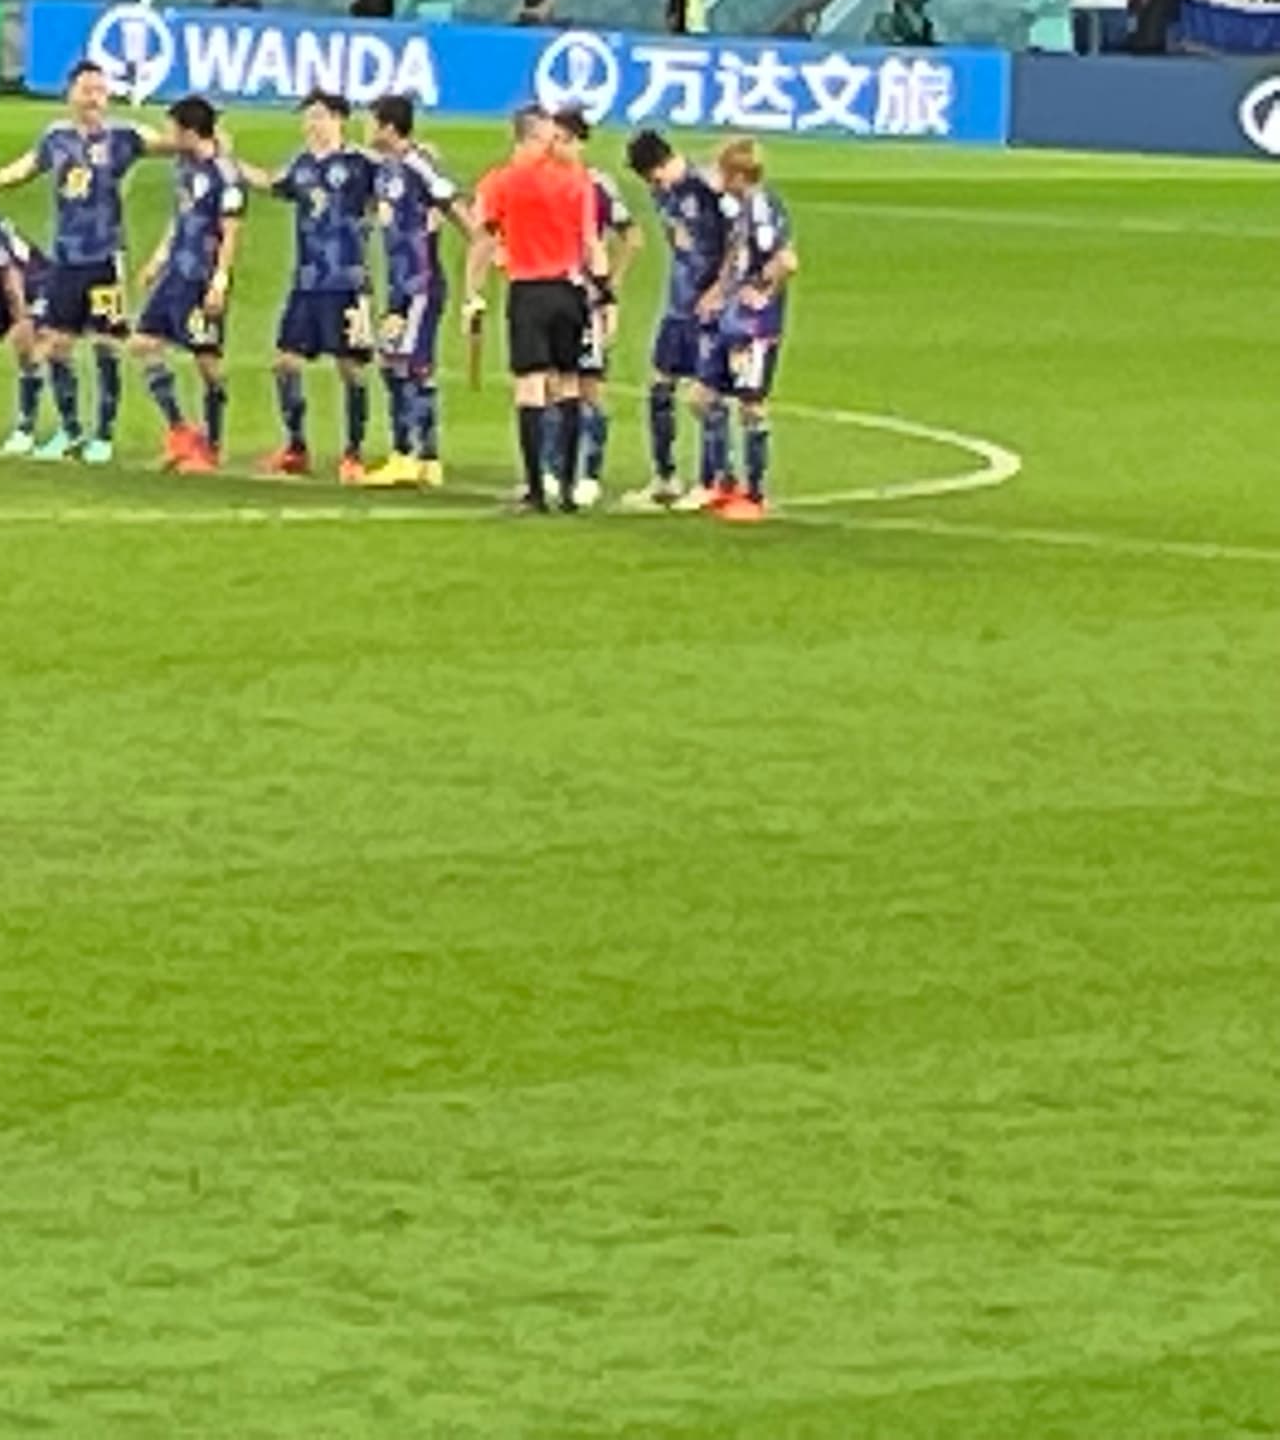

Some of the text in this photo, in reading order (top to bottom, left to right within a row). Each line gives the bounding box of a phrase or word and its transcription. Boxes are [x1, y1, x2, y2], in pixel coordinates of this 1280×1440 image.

[184, 23, 439, 107] WANDA
[627, 47, 955, 136] 万达文旅
